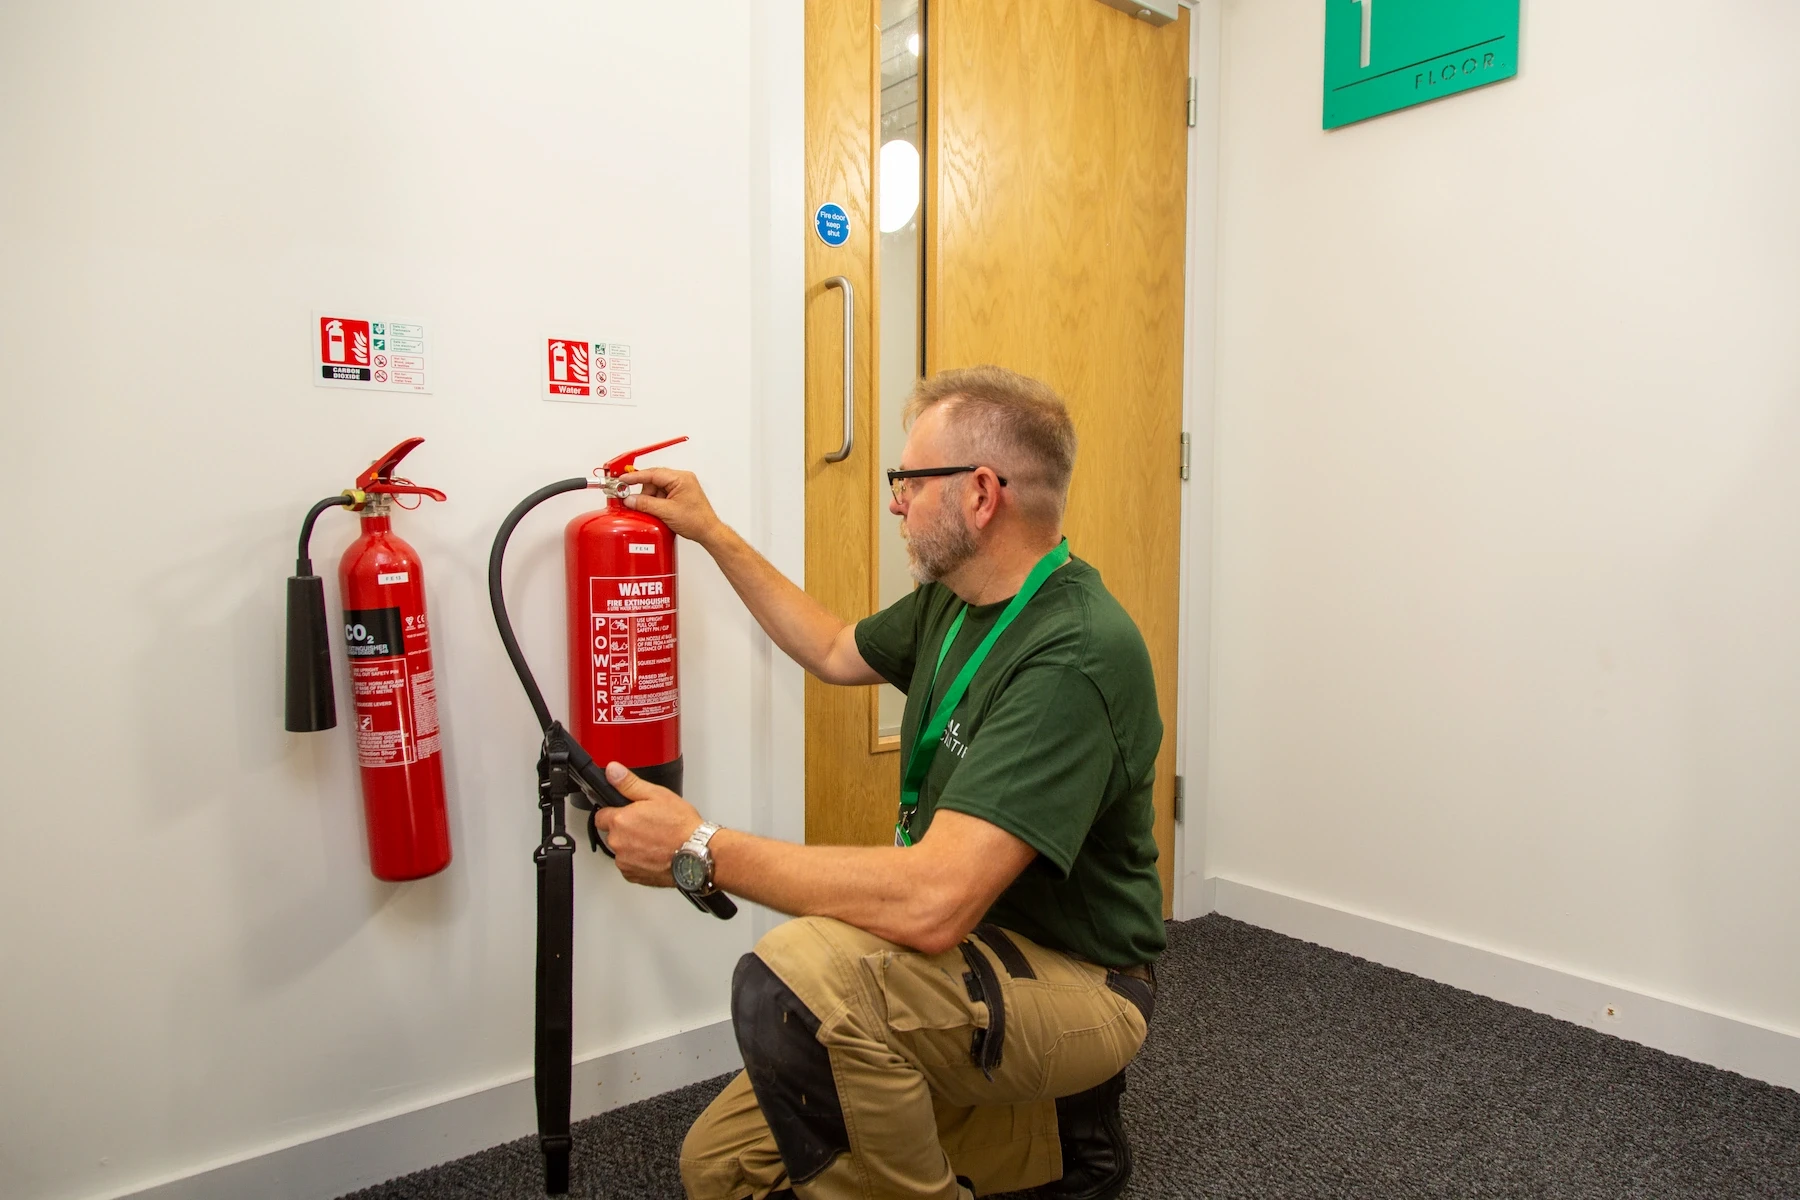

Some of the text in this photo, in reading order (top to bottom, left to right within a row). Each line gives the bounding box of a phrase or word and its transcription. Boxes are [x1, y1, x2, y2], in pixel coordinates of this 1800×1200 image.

[1415, 52, 1495, 90] FLOOR
[820, 211, 846, 221] Fire door
[826, 220, 841, 229] keep
[827, 229, 840, 237] shut
[558, 385, 582, 395] Water
[618, 582, 663, 596] WATER
[607, 599, 622, 607] FIRE
[624, 597, 670, 607] EXTINGUISHER
[622, 676, 629, 684] A
